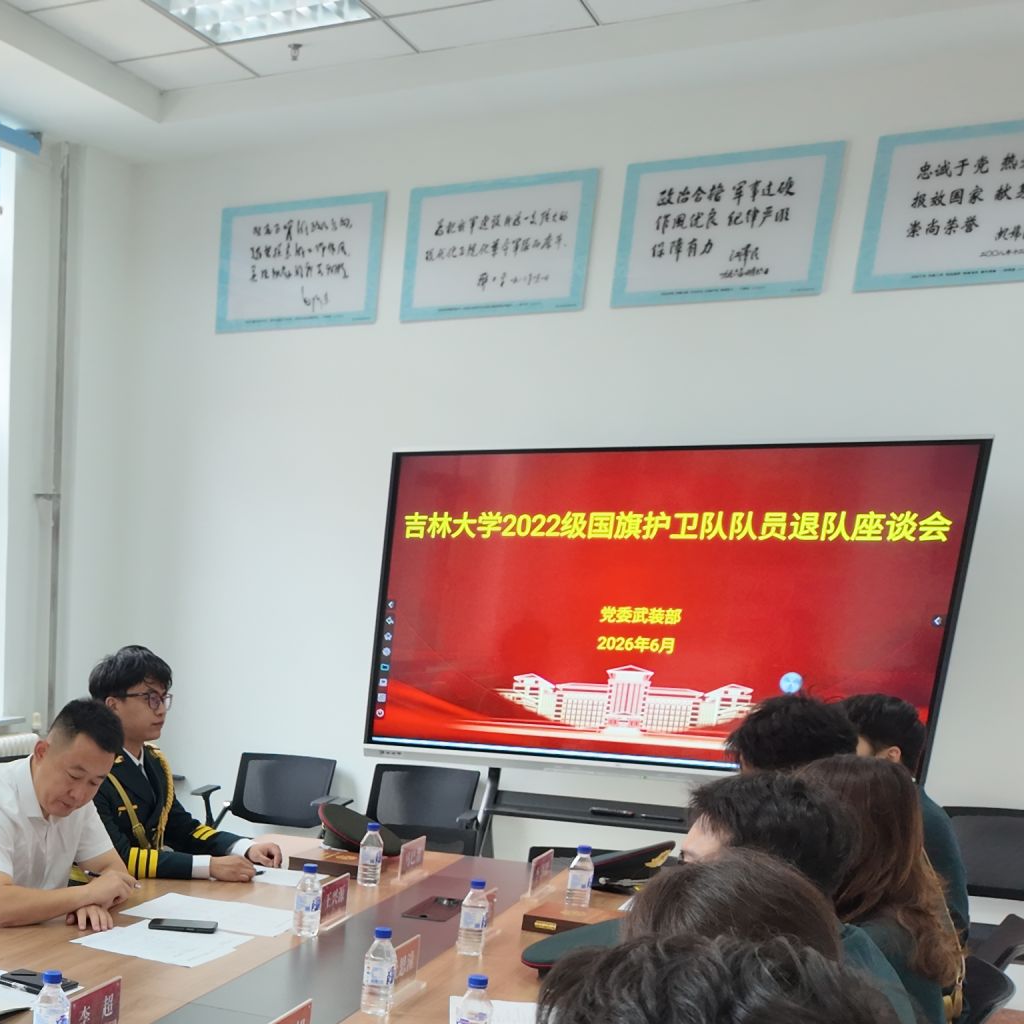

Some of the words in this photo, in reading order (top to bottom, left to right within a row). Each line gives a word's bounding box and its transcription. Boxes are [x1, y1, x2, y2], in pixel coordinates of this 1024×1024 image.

[917, 155, 989, 180] 忠诚于党
[1000, 153, 1024, 171] 热
[657, 183, 725, 207] 政治合格
[911, 185, 984, 208] 报效国家
[907, 215, 979, 238] 崇尚荣誉
[652, 238, 714, 262] 保障有力
[404, 510, 952, 543] 吉林大学2022级国旗护卫队队员退队座谈会
[599, 606, 682, 625] 党委武装部
[597, 636, 675, 654] 2026年6月
